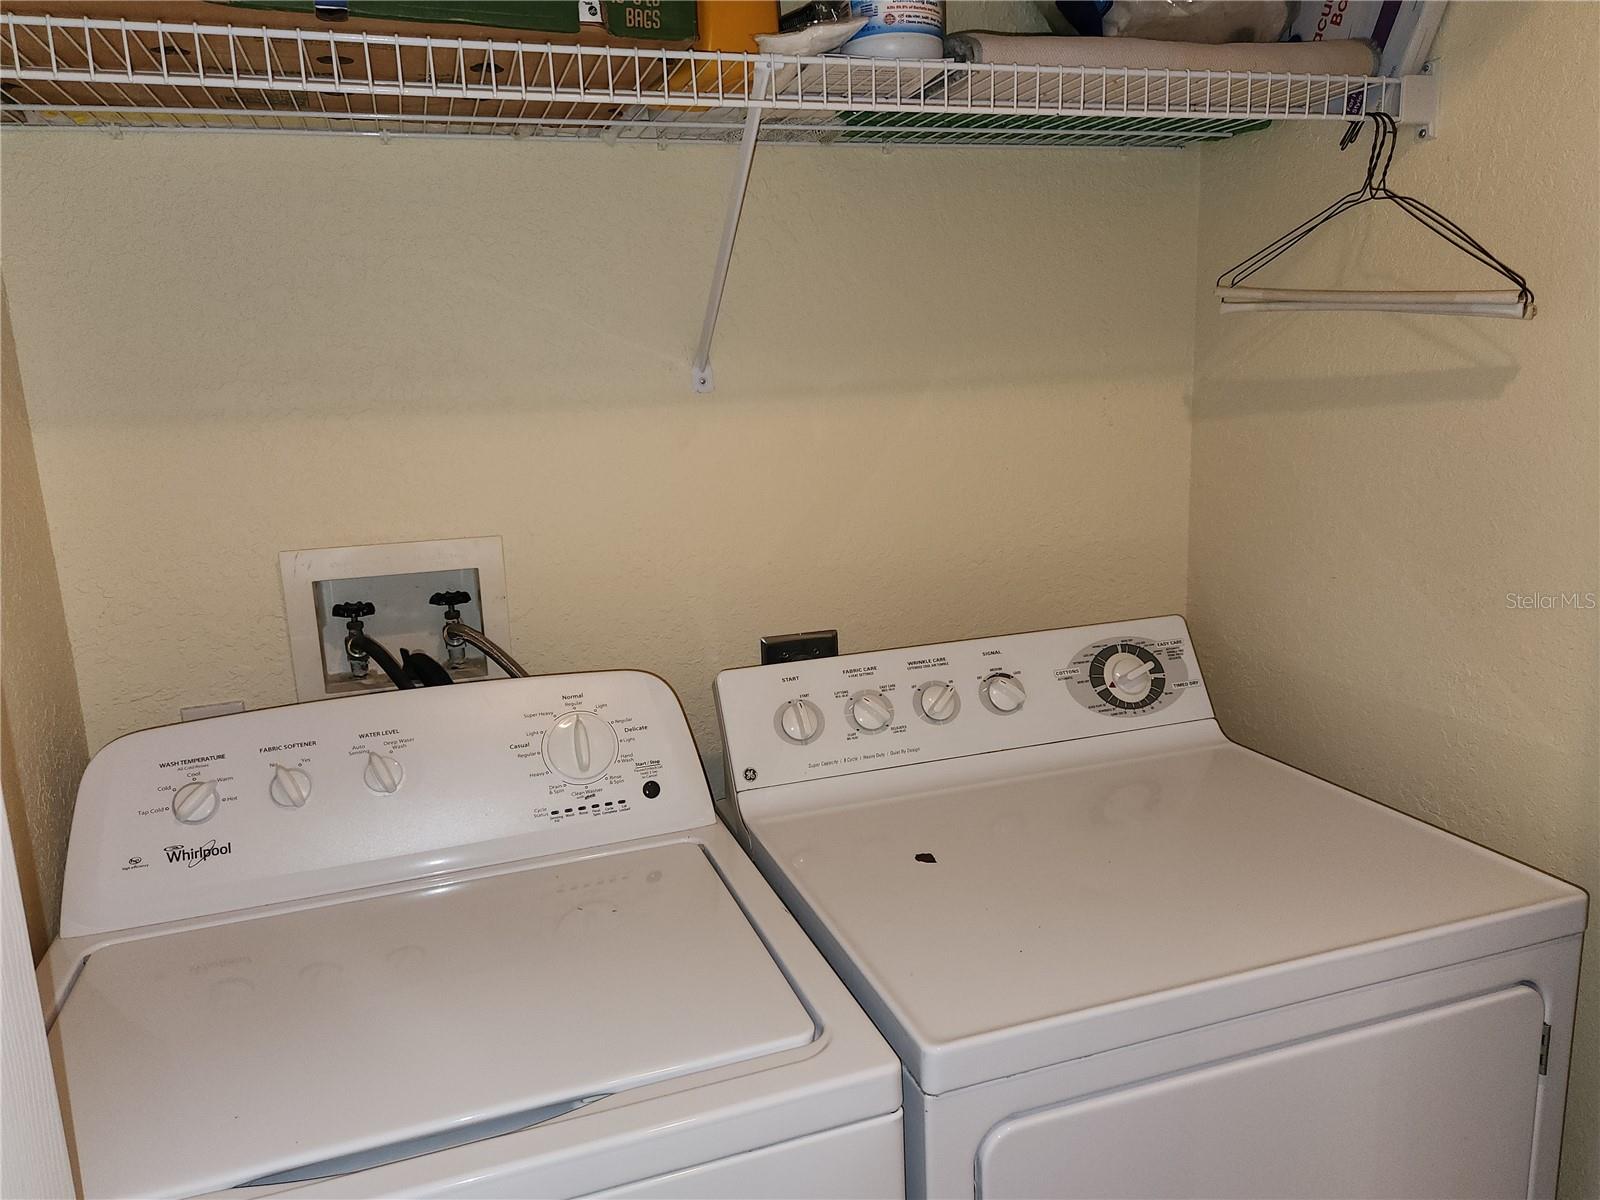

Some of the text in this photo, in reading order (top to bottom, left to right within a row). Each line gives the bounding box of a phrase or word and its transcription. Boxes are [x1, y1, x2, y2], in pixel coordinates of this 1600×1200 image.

[626, 8, 660, 28] BAGS
[1313, 0, 1333, 41] acu
[358, 731, 381, 739] WATER
[259, 740, 317, 753] FABRIC SOFTENER
[158, 754, 226, 769] WASH TEMPERATURE
[166, 842, 232, 864] Whirlpool
